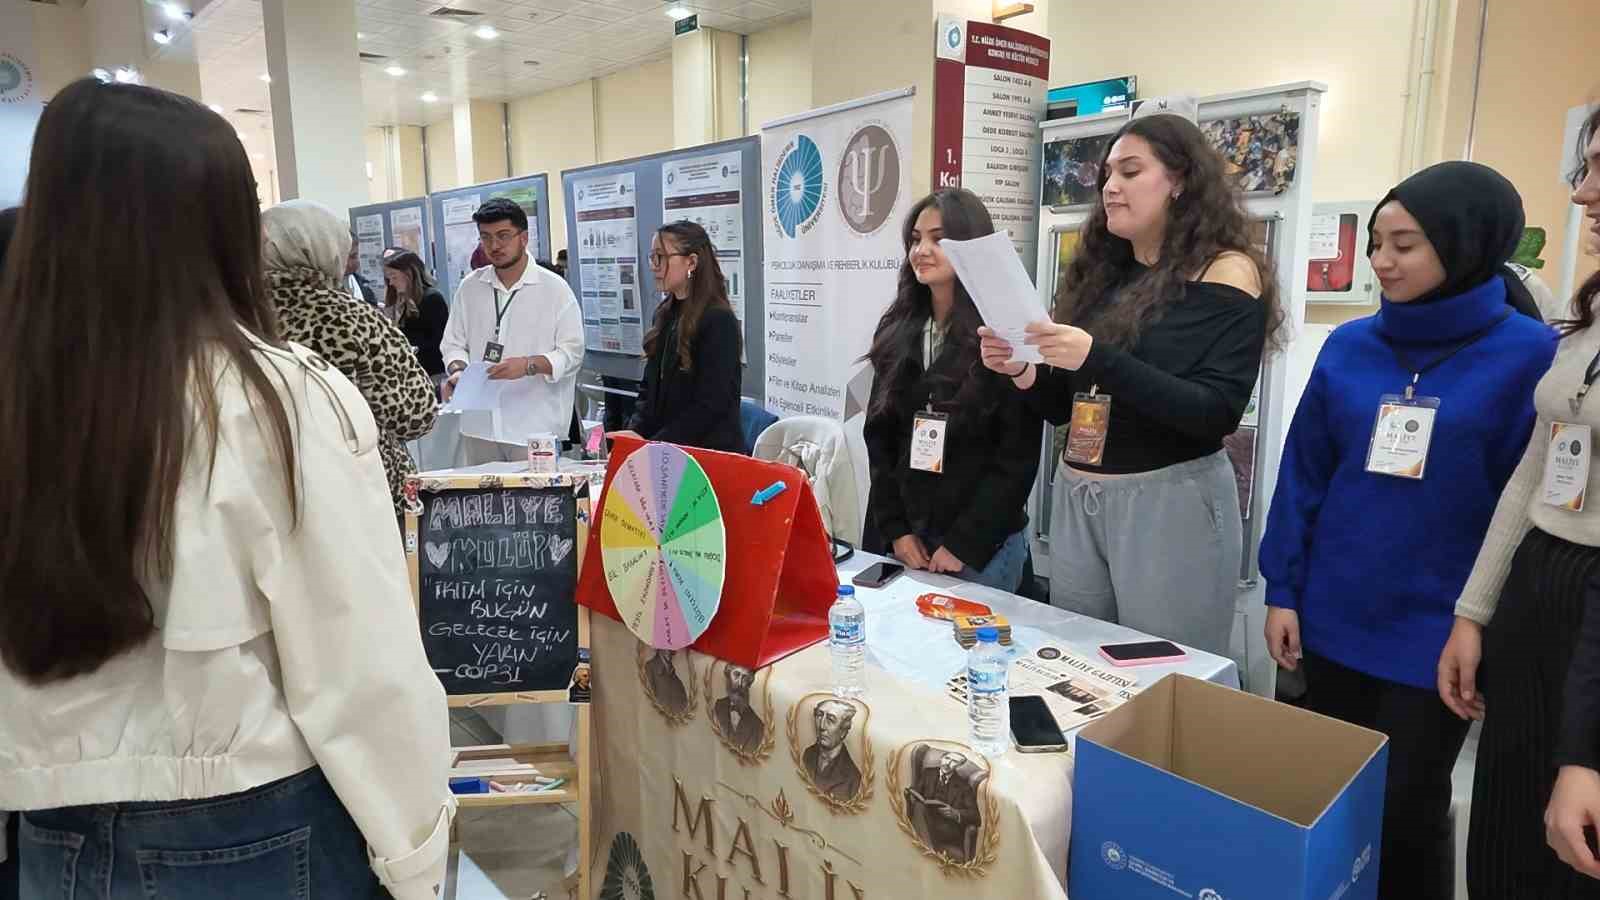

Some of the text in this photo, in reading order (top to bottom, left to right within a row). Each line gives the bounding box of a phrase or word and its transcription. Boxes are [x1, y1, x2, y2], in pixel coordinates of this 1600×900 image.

[993, 73, 1010, 83] SALON
[992, 92, 1010, 100] SALON
[429, 490, 564, 531] MALİYE
[471, 599, 548, 621] BUGÜN
[429, 622, 524, 641] GELECEK
